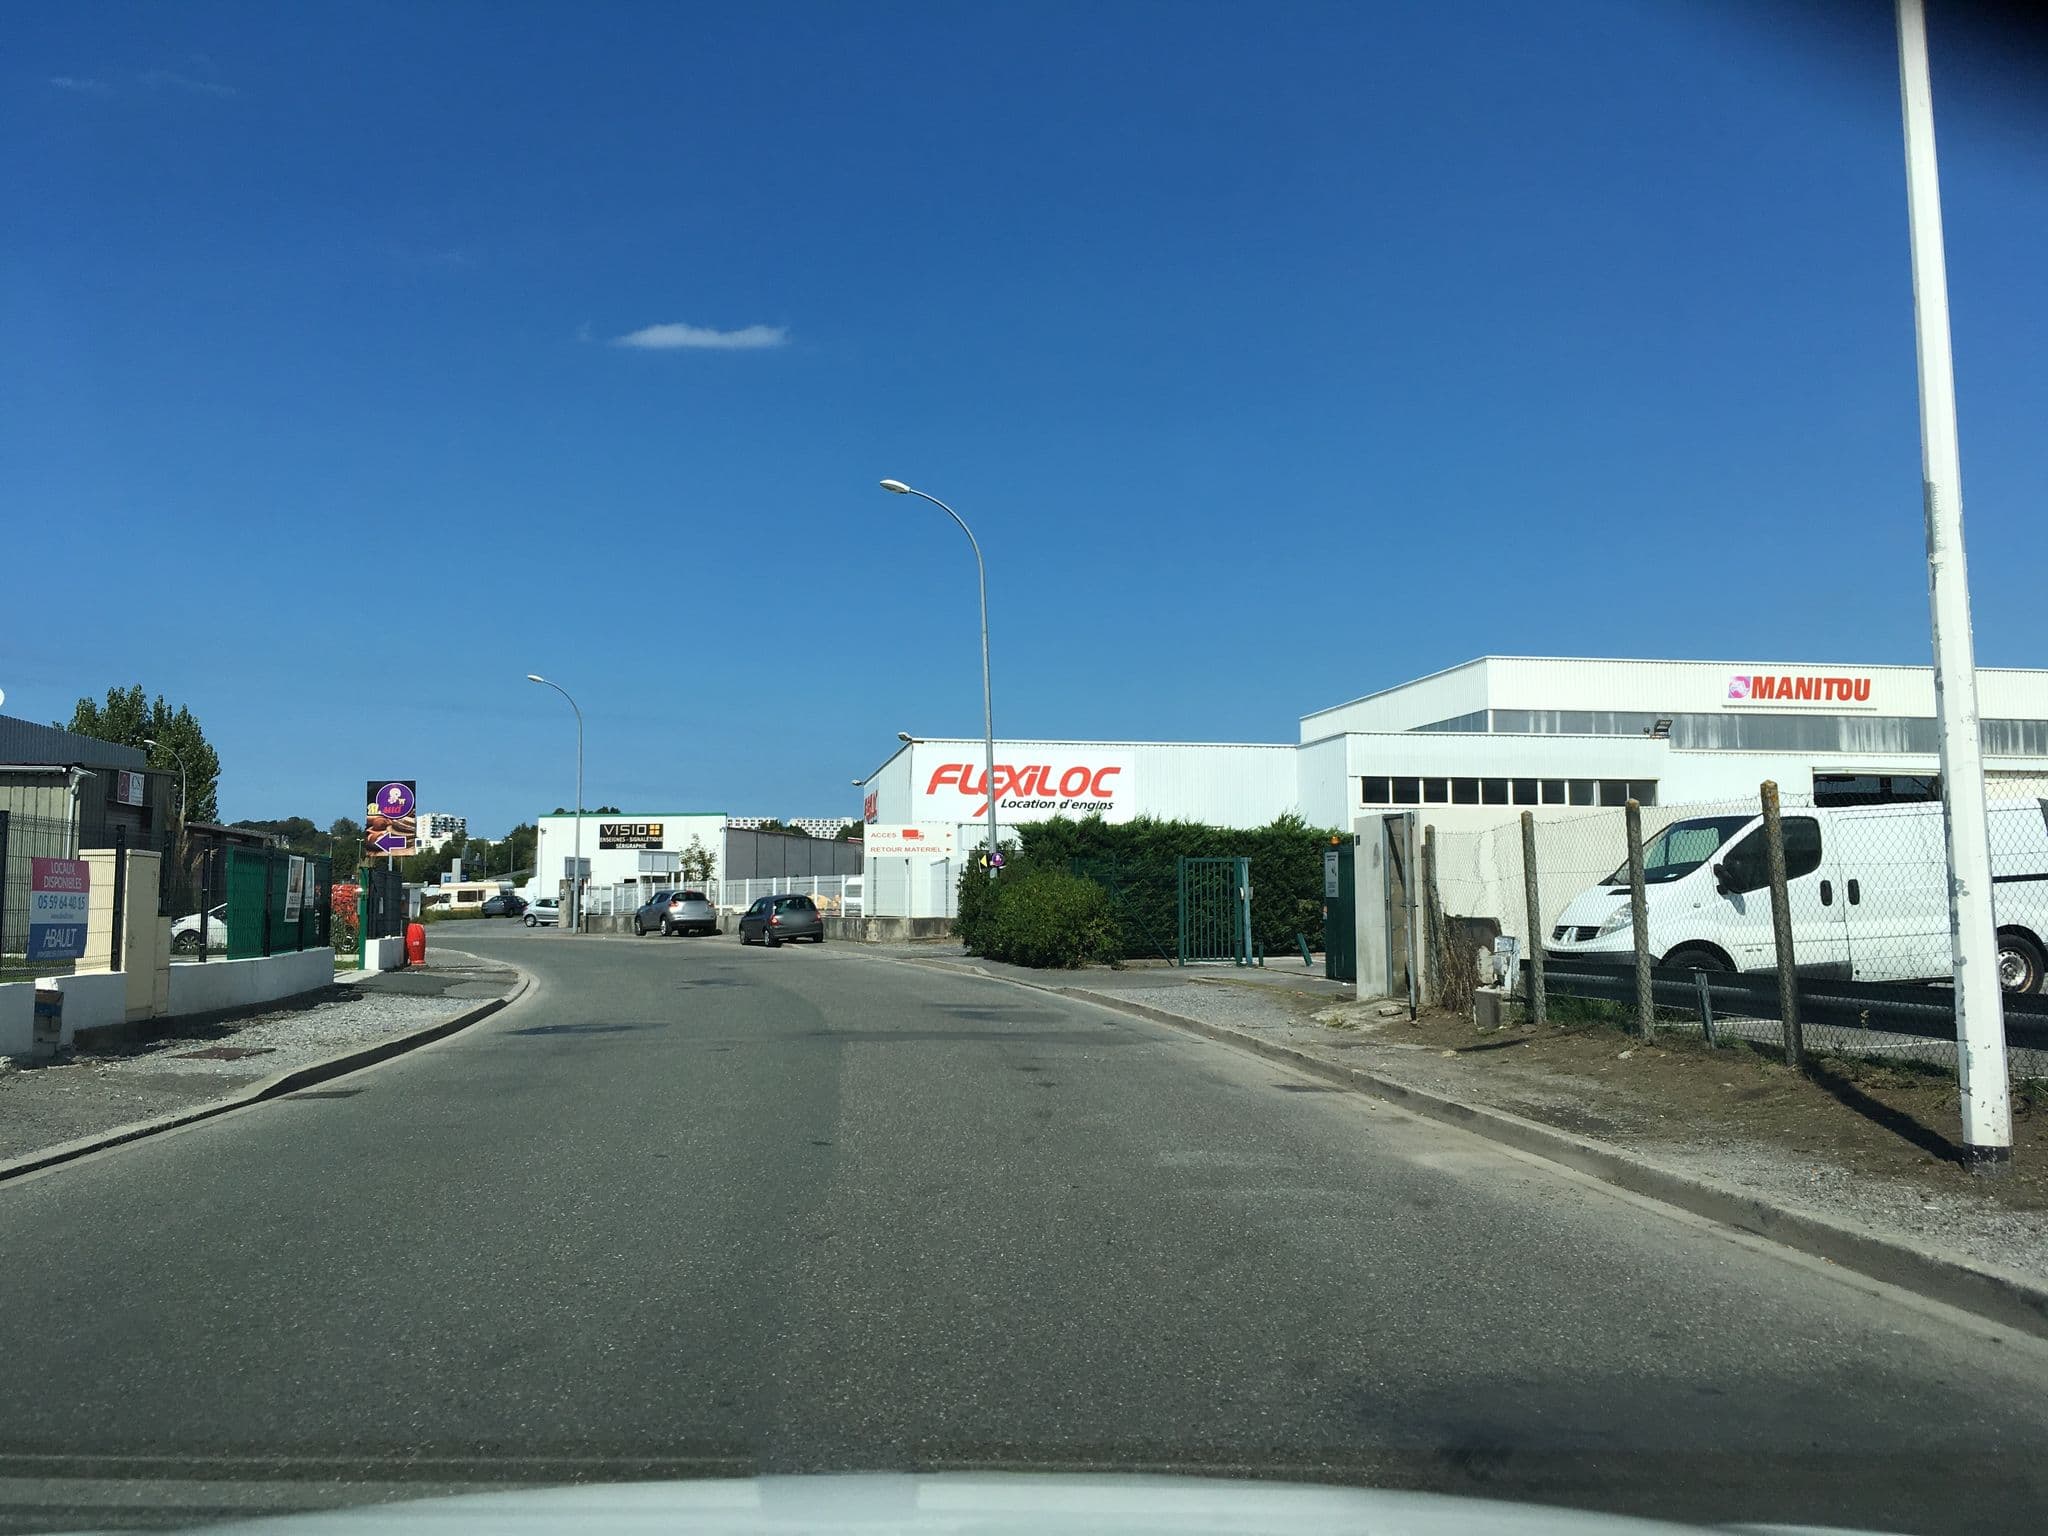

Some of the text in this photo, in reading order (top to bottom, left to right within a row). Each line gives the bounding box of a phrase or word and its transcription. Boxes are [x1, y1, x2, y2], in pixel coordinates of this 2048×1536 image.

[1751, 676, 1871, 701] MANITOU
[1000, 798, 1114, 812] Location d'engins
[603, 824, 647, 836] VISIO
[43, 875, 82, 889] DISPONIBLES
[38, 895, 48, 909] 05
[49, 895, 58, 910] 59
[43, 928, 77, 948] ABAULT
